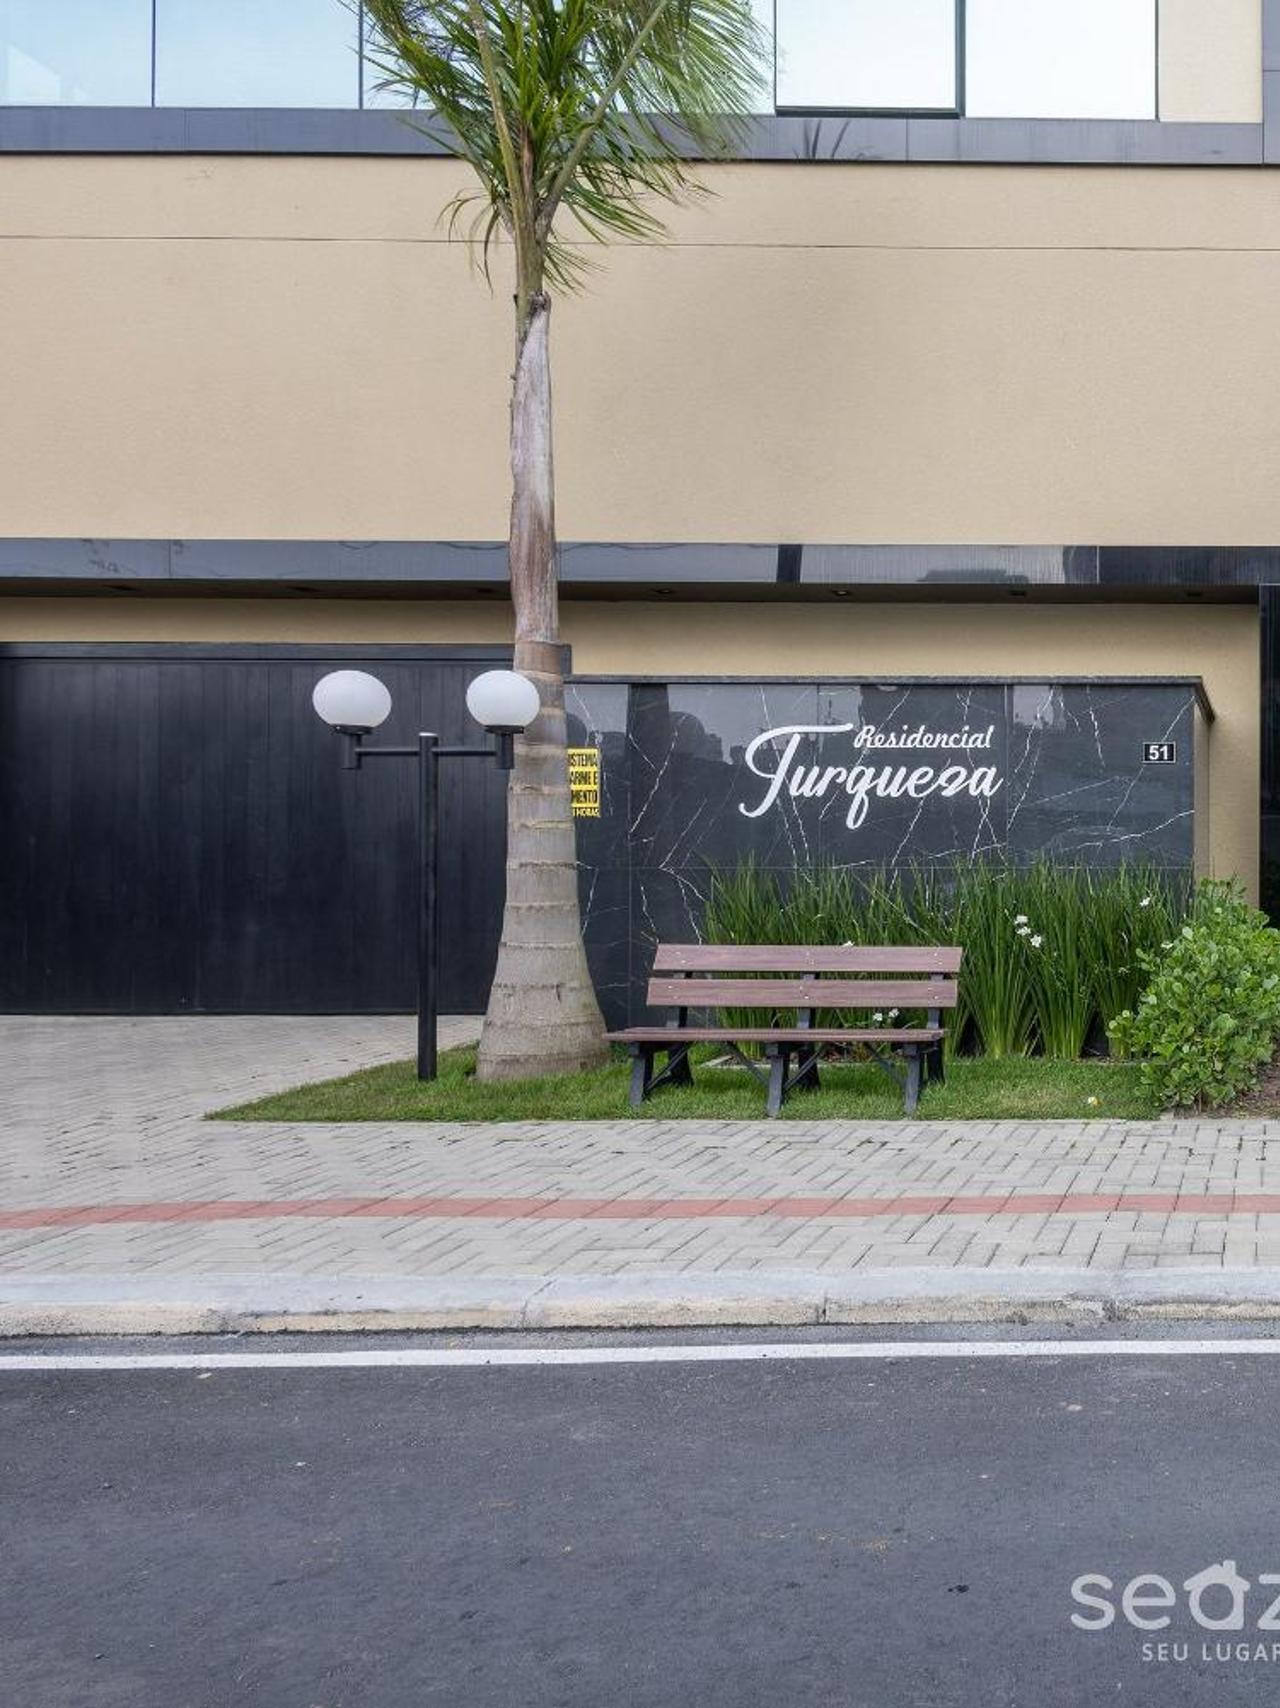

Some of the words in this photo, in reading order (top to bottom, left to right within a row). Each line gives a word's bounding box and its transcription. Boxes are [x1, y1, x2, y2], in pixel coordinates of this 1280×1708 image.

[854, 724, 995, 749] Residencial
[1149, 744, 1168, 760] 51
[568, 753, 597, 767] ISTEMA
[569, 771, 592, 785] ARME
[571, 789, 598, 804] MENTO
